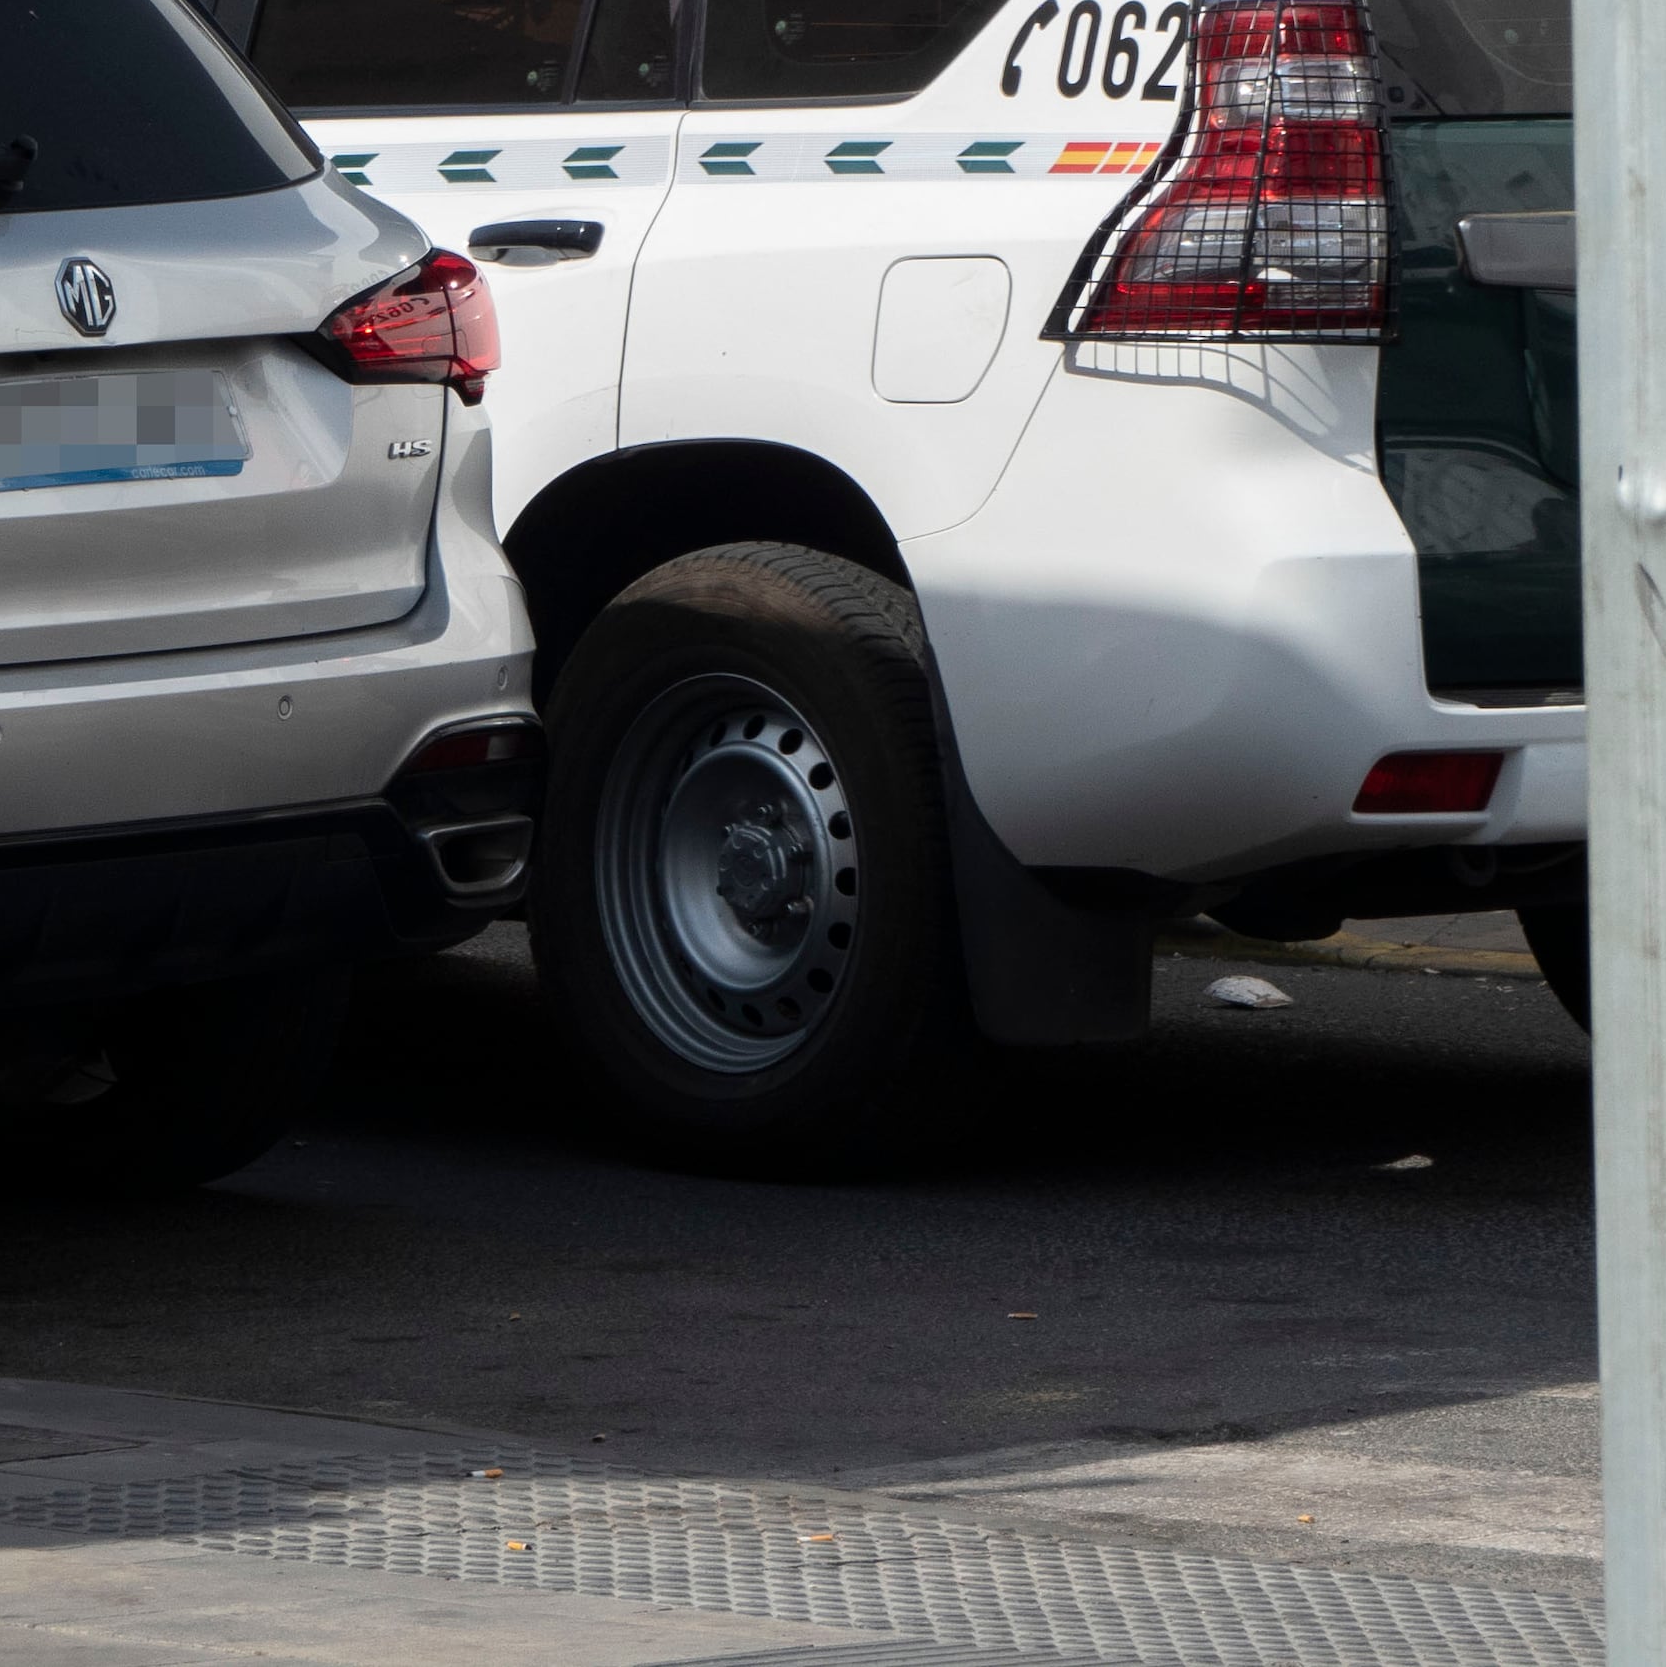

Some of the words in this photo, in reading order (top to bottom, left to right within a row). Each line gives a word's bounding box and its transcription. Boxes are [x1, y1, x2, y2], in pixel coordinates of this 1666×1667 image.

[1057, 0, 1190, 101] 062
[64, 265, 114, 327] MG
[388, 439, 432, 460] HS
